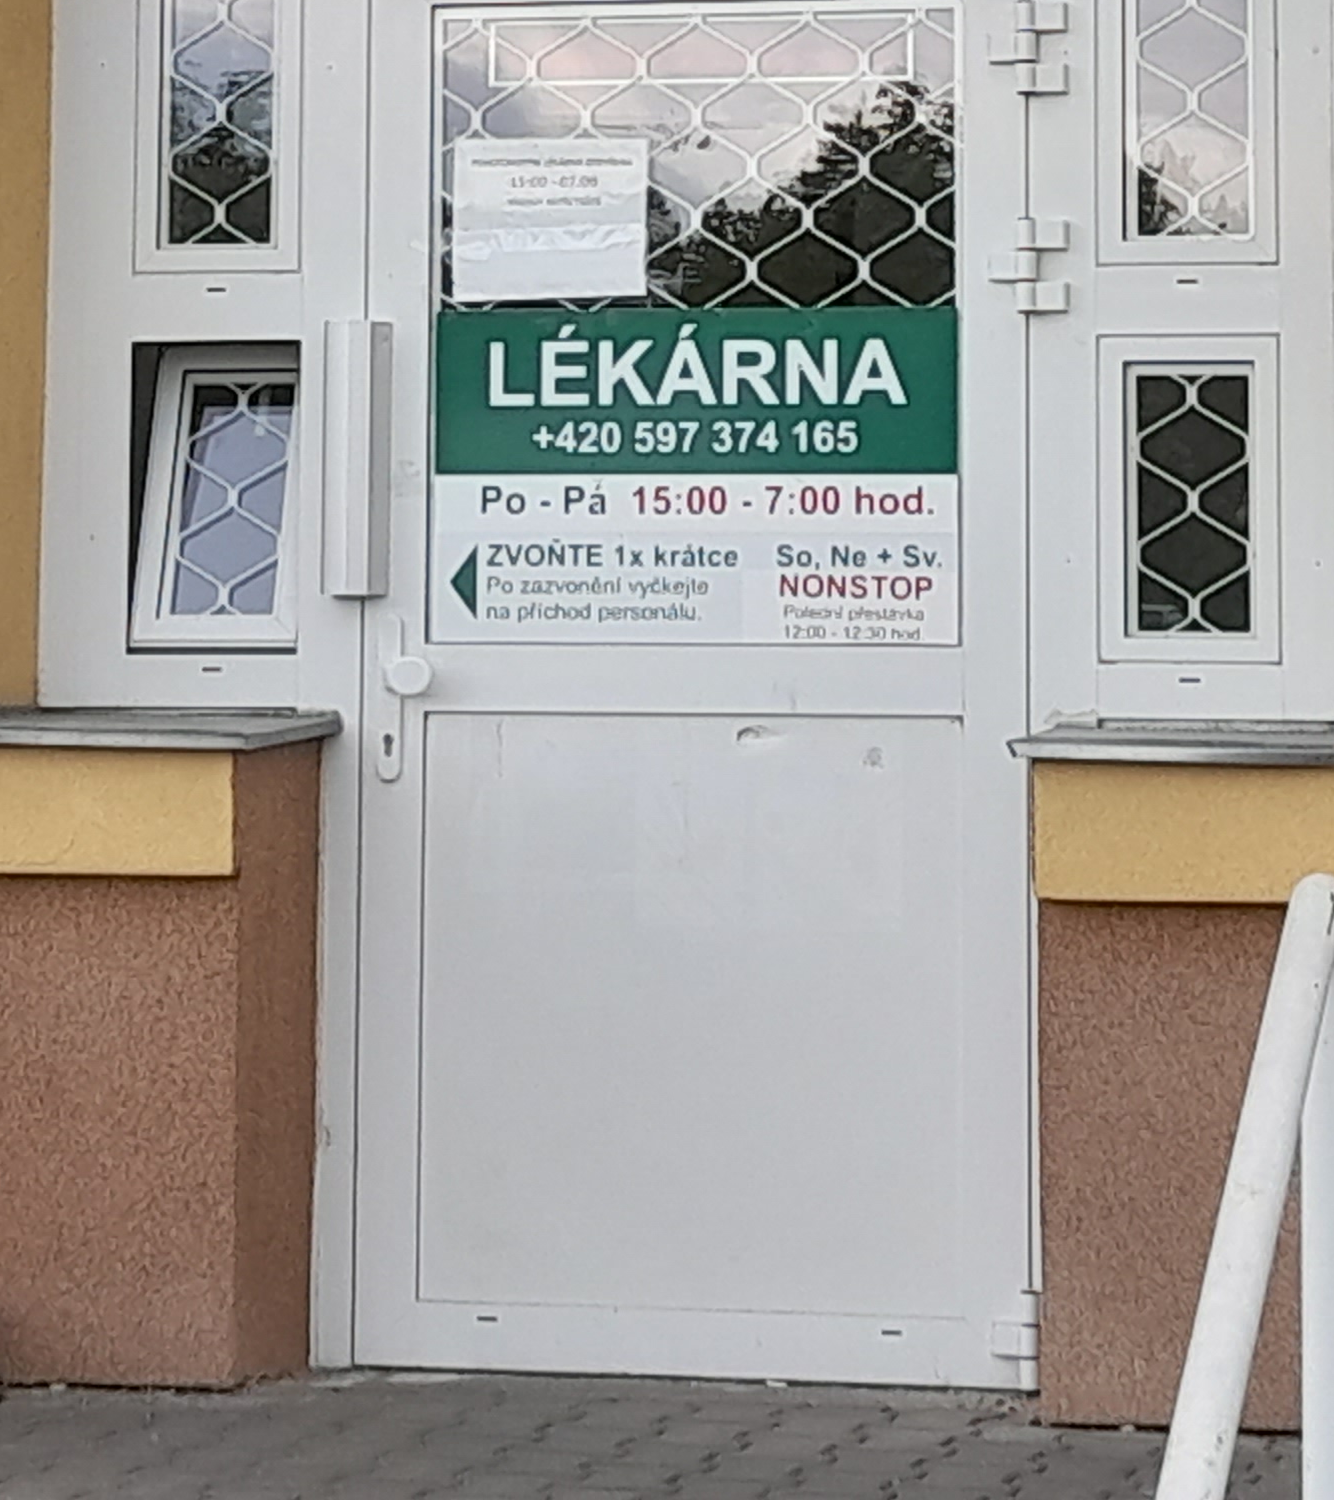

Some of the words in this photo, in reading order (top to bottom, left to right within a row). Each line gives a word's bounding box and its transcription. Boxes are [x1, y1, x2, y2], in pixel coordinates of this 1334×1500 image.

[488, 323, 908, 407] LÉKÁRNA
[531, 421, 621, 454] +420
[633, 420, 699, 453] 597
[710, 420, 779, 453] 374
[791, 420, 859, 454] 165
[480, 485, 526, 515] Po
[563, 479, 606, 515] Pá
[631, 485, 728, 515] 15:00
[765, 485, 841, 515] 7:00
[854, 485, 936, 515] hod.
[485, 539, 604, 568] ZVOŇTE
[614, 545, 644, 568] 1x
[654, 544, 739, 568] krátce
[776, 544, 820, 570] So,
[830, 545, 867, 568] Ne
[877, 548, 892, 564] +
[903, 544, 943, 568] Sv.
[486, 576, 514, 595] Po
[779, 574, 933, 601] NONSTOP
[486, 605, 511, 620] na
